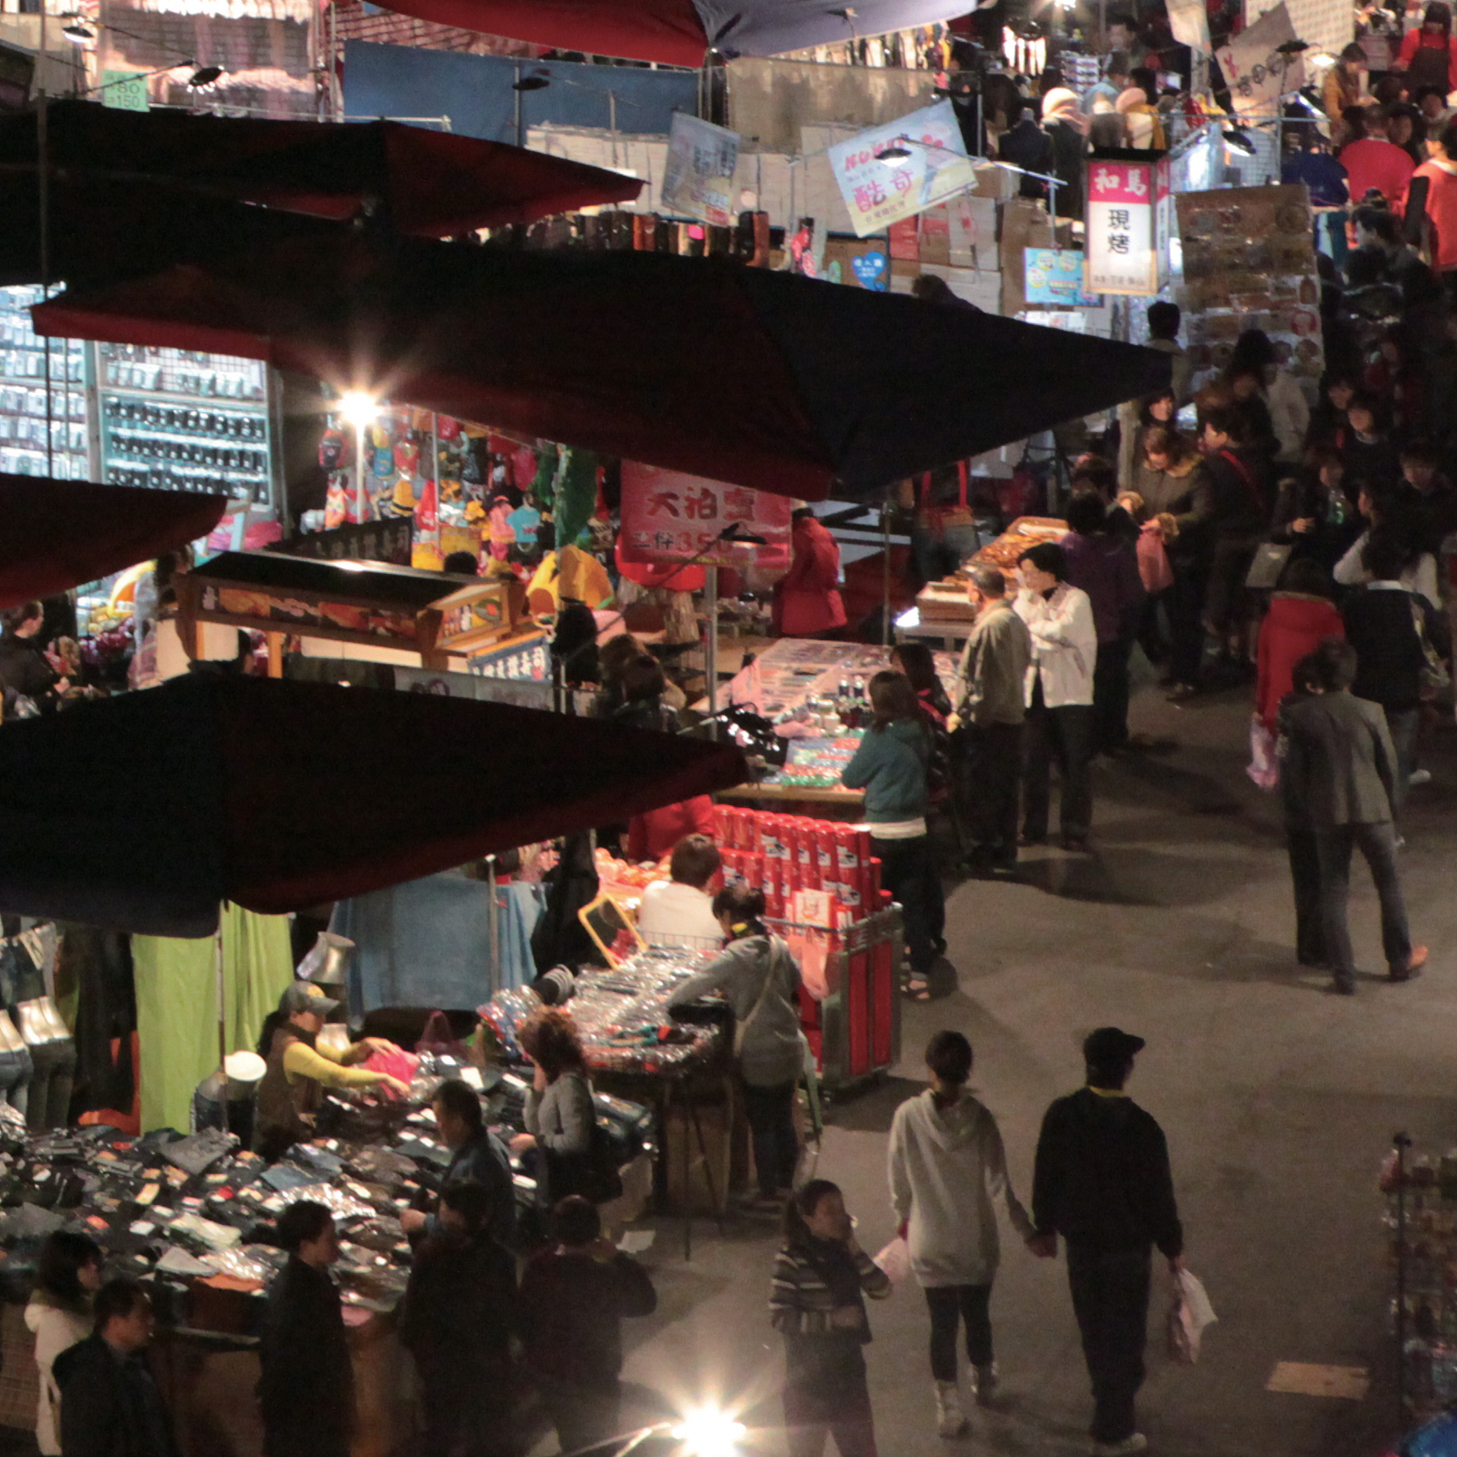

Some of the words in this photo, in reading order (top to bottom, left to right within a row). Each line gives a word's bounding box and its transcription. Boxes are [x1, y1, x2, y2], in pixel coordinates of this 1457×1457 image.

[1107, 208, 1131, 256] 現烤
[647, 487, 756, 522] 大拍賣
